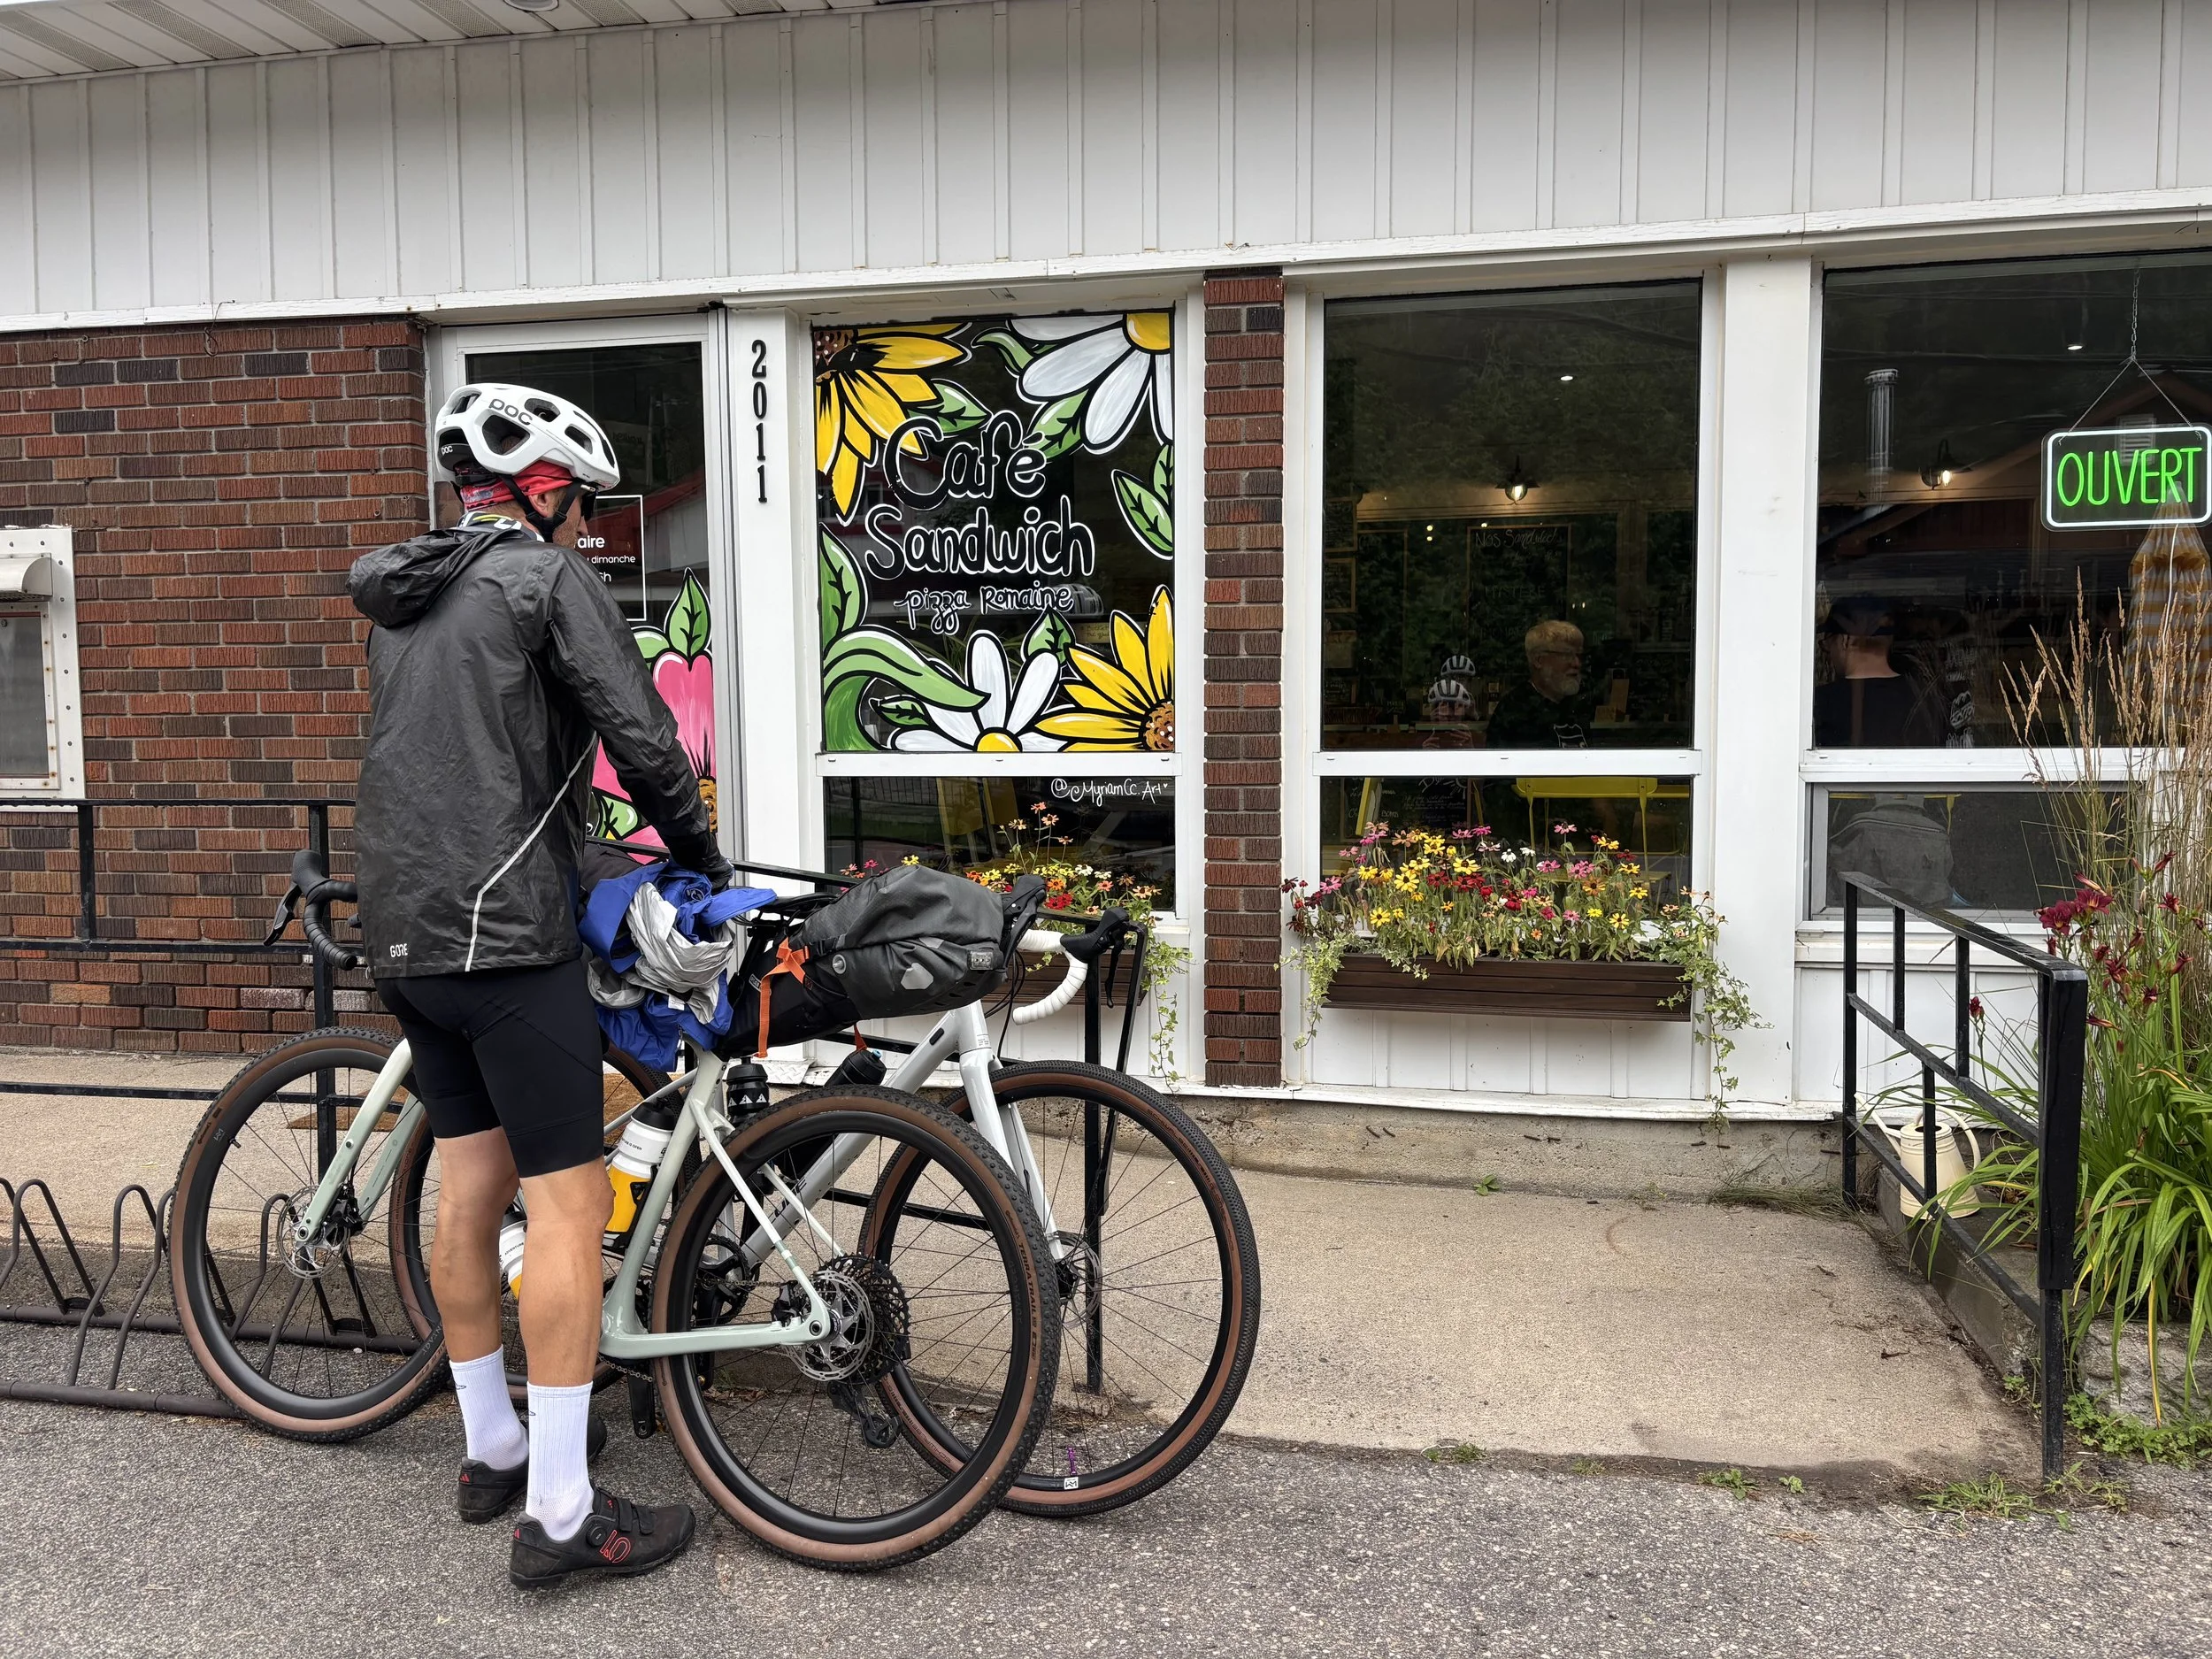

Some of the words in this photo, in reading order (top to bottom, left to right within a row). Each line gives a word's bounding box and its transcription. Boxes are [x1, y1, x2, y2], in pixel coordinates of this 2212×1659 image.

[751, 339, 768, 503] 2011
[883, 410, 1048, 511] Café
[2057, 447, 2203, 507] OUVERT
[573, 535, 605, 549] aire
[591, 555, 636, 564] dimanche
[864, 495, 1096, 580] Sandwich
[894, 588, 972, 635] pizza
[979, 580, 1074, 614] Romaine
[389, 943, 408, 957] GORE
[1018, 1242, 1033, 1280] TERRA
[1026, 1280, 1037, 1317] TRAIL
